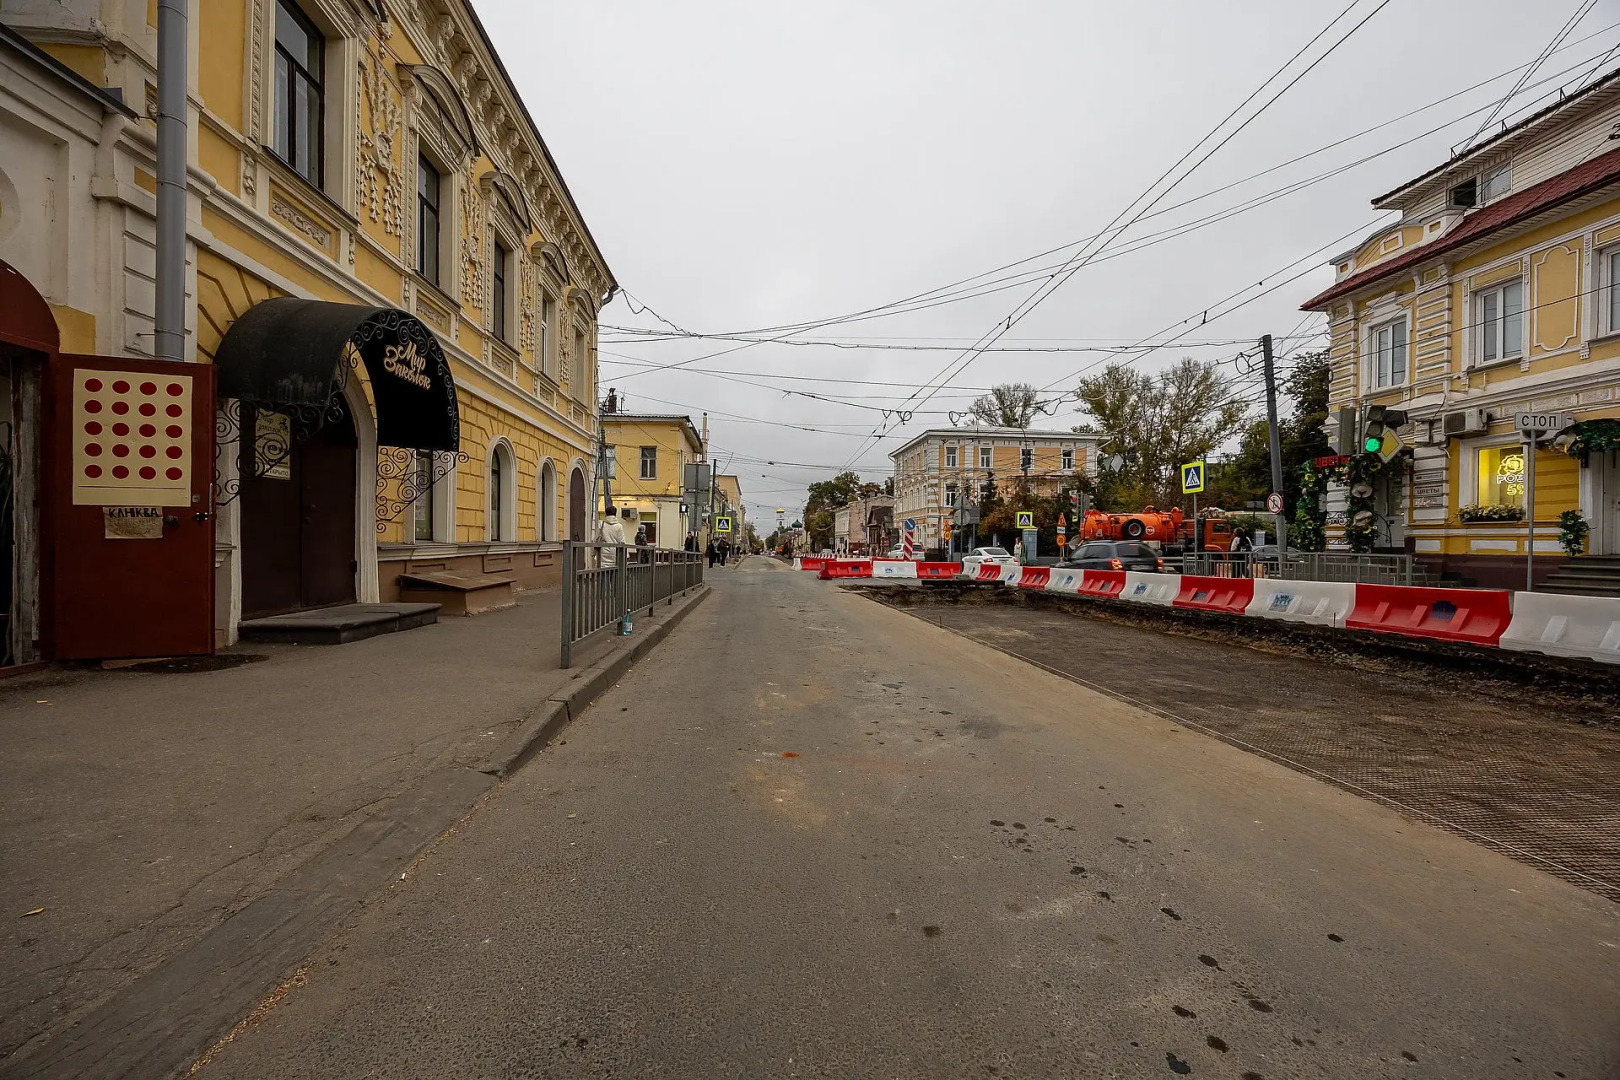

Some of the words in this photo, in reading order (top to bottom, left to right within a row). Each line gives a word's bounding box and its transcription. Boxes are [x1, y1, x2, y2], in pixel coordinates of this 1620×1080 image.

[384, 344, 431, 390] Заколок
[397, 340, 426, 374] Мир
[1521, 415, 1557, 428] СТОП
